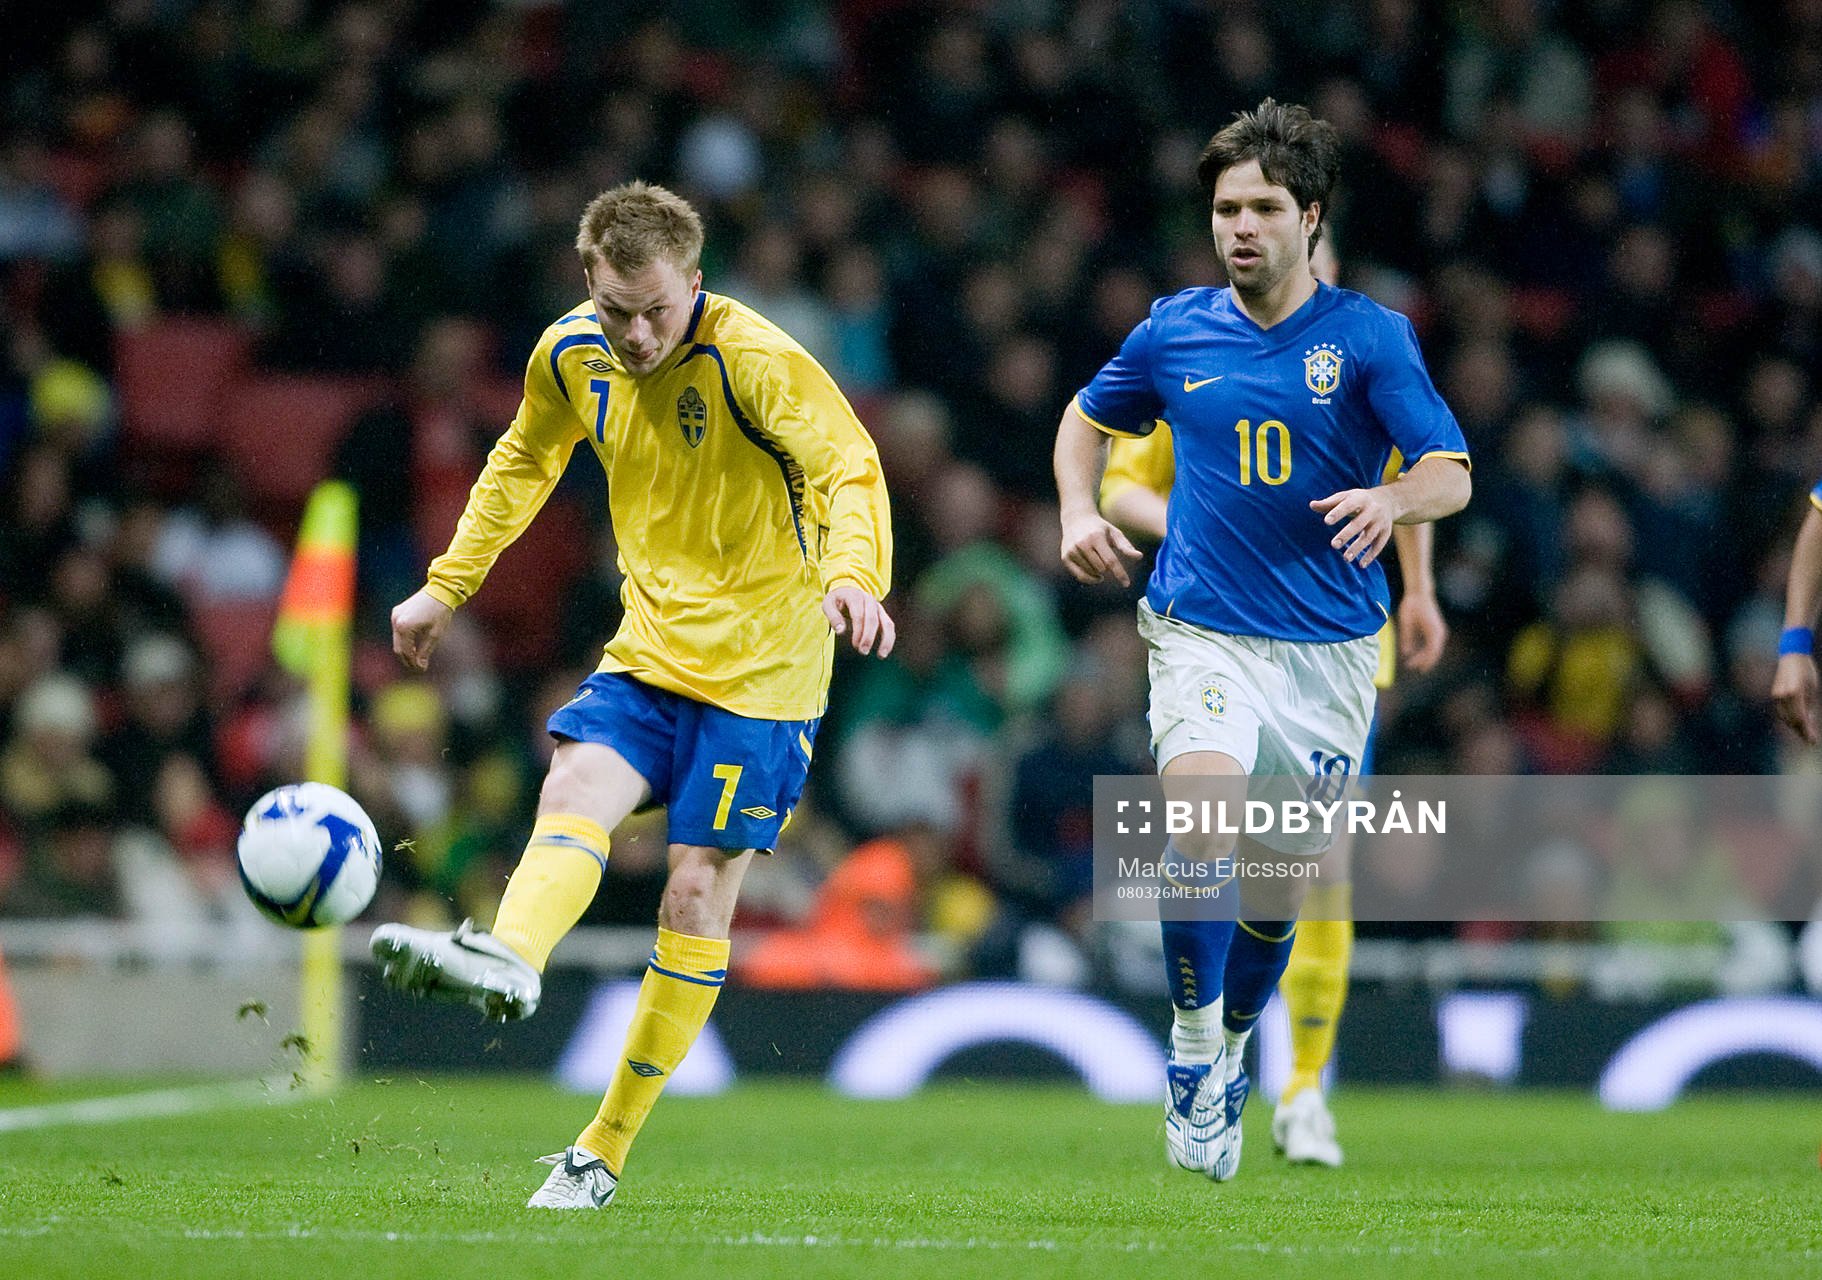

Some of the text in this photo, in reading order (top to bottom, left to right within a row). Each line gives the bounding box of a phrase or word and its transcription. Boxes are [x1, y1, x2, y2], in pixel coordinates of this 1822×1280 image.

[590, 379, 610, 444] 7
[1235, 419, 1292, 486] 10
[713, 763, 744, 831] 7
[1305, 750, 1351, 811] 10
